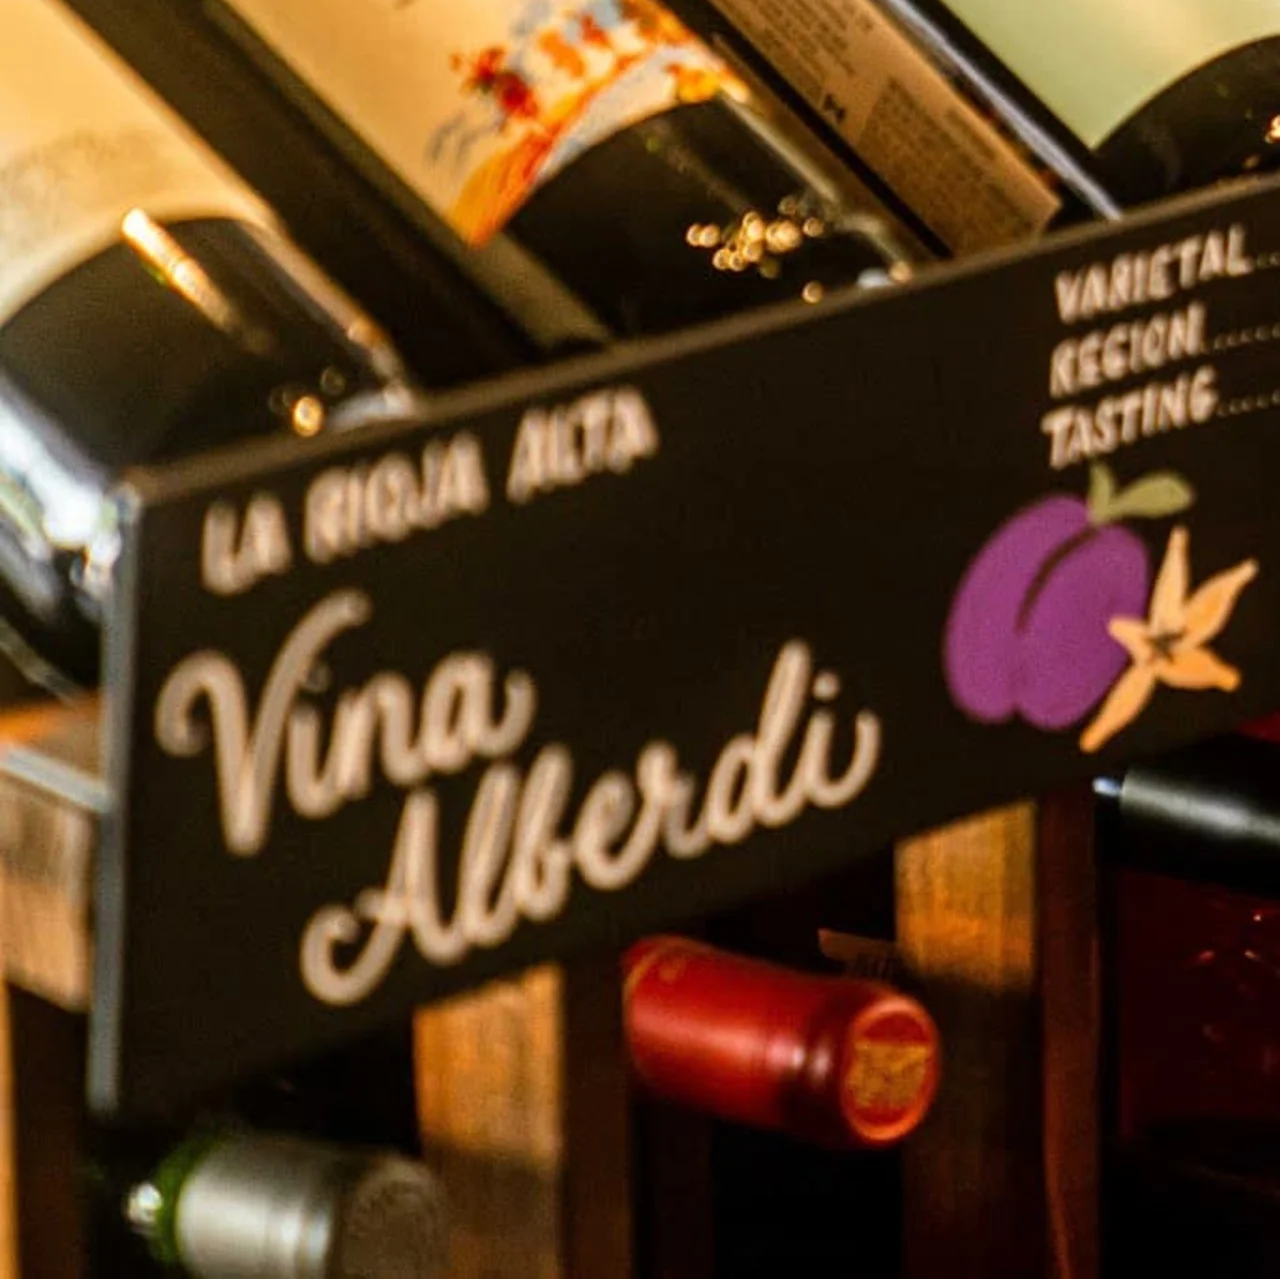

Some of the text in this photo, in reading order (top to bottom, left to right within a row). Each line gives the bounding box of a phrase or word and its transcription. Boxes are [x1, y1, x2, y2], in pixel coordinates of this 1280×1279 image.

[1049, 300, 1206, 399] REGION
[1054, 223, 1253, 323] VARIETAL
[202, 384, 662, 595] LA RIOJA ALTA
[1041, 367, 1219, 471] TASTING
[154, 588, 538, 856] Vina
[299, 638, 880, 1006] Alberdi
